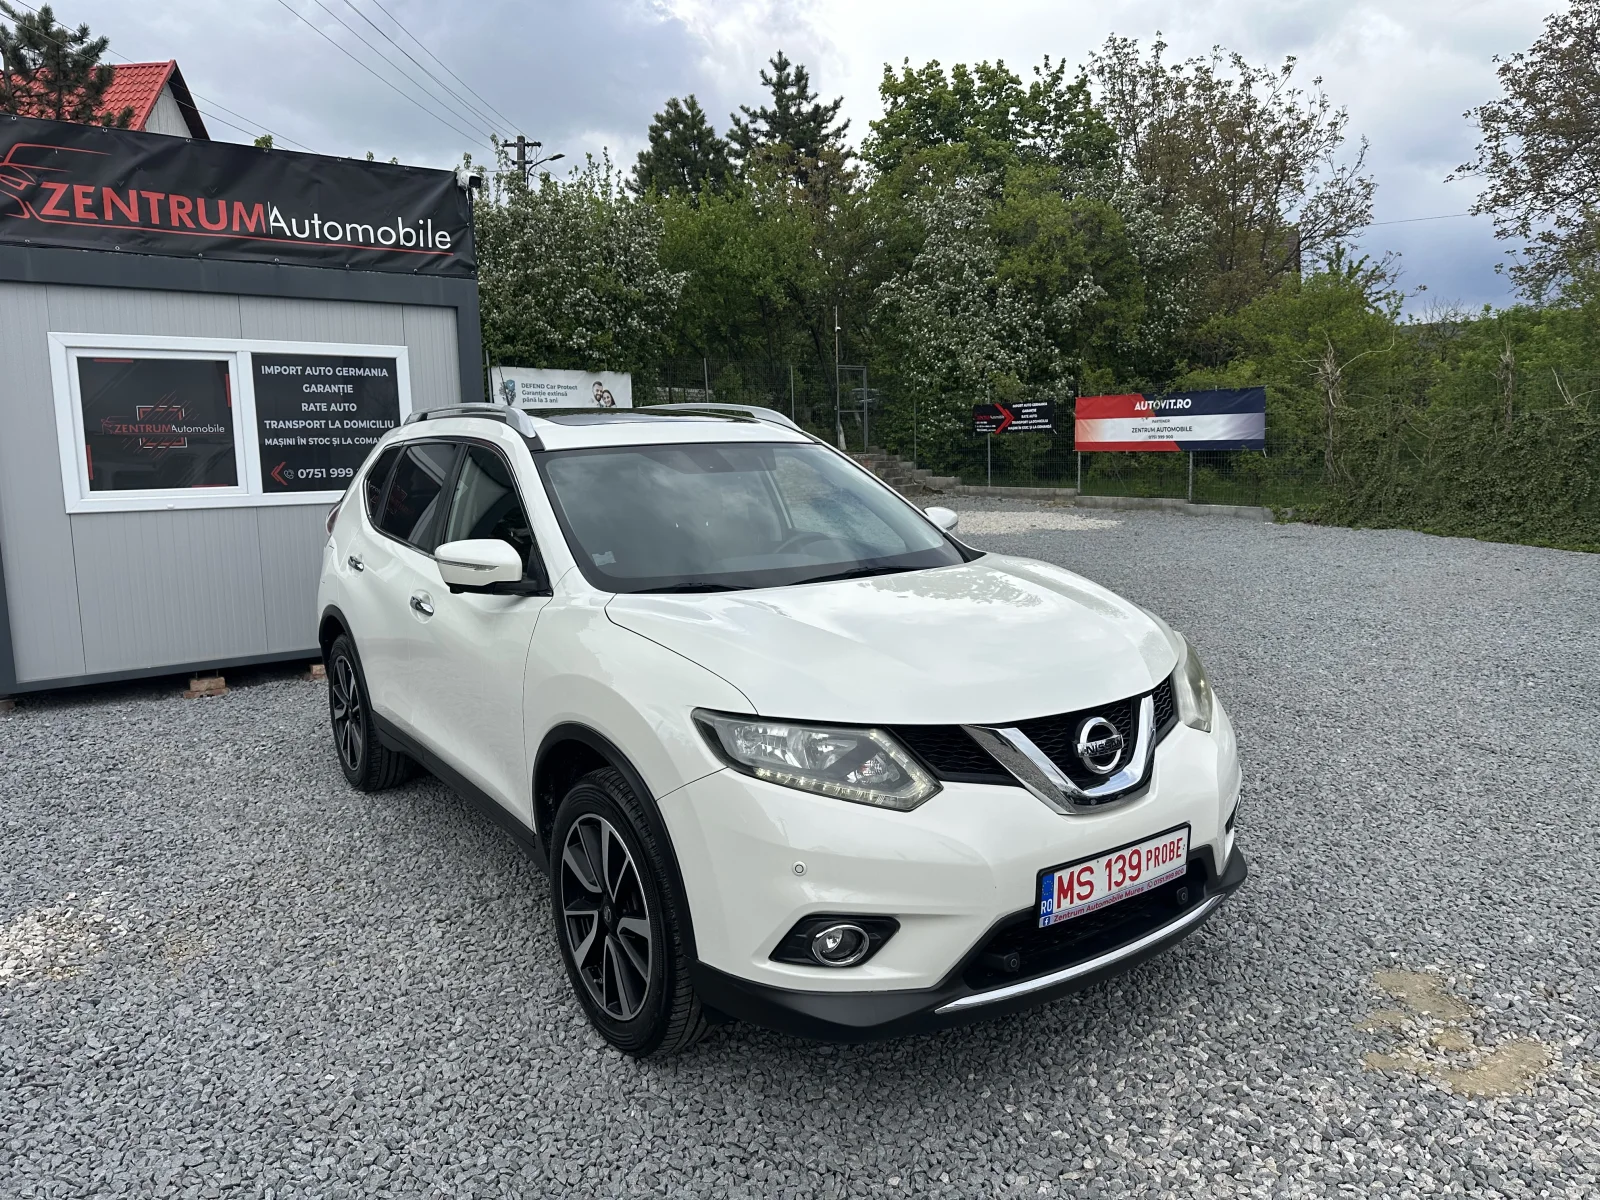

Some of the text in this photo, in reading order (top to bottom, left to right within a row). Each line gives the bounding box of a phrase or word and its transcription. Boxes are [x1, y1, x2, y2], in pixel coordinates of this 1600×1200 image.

[40, 181, 452, 250] ZENTRUM Automobile
[261, 365, 388, 377] IMPORT AUTO GERMANIA
[303, 383, 353, 395] GARANȚIE
[301, 403, 357, 412] RATE AUTO
[1134, 398, 1192, 411] AUTOVIT.RO
[114, 424, 225, 433] ZENTRUM Automobile
[264, 420, 395, 429] TRANSPORT LA DOMICILIU
[1156, 425, 1193, 433] AUTOMOBILE
[265, 437, 296, 448] MAȘINI
[297, 436, 307, 446] ÎN
[308, 437, 331, 445] STOC
[332, 437, 340, 447] ȘI
[341, 437, 353, 445] LA
[298, 468, 326, 479] 0751
[329, 467, 354, 478] 999
[1086, 738, 1122, 755] NISSAN
[1057, 837, 1183, 909] MS 139 PROBE
[1041, 898, 1053, 915] RO
[1053, 908, 1085, 923] Zentrum
[1086, 893, 1124, 913] Automobile
[1124, 886, 1145, 899] Mures
